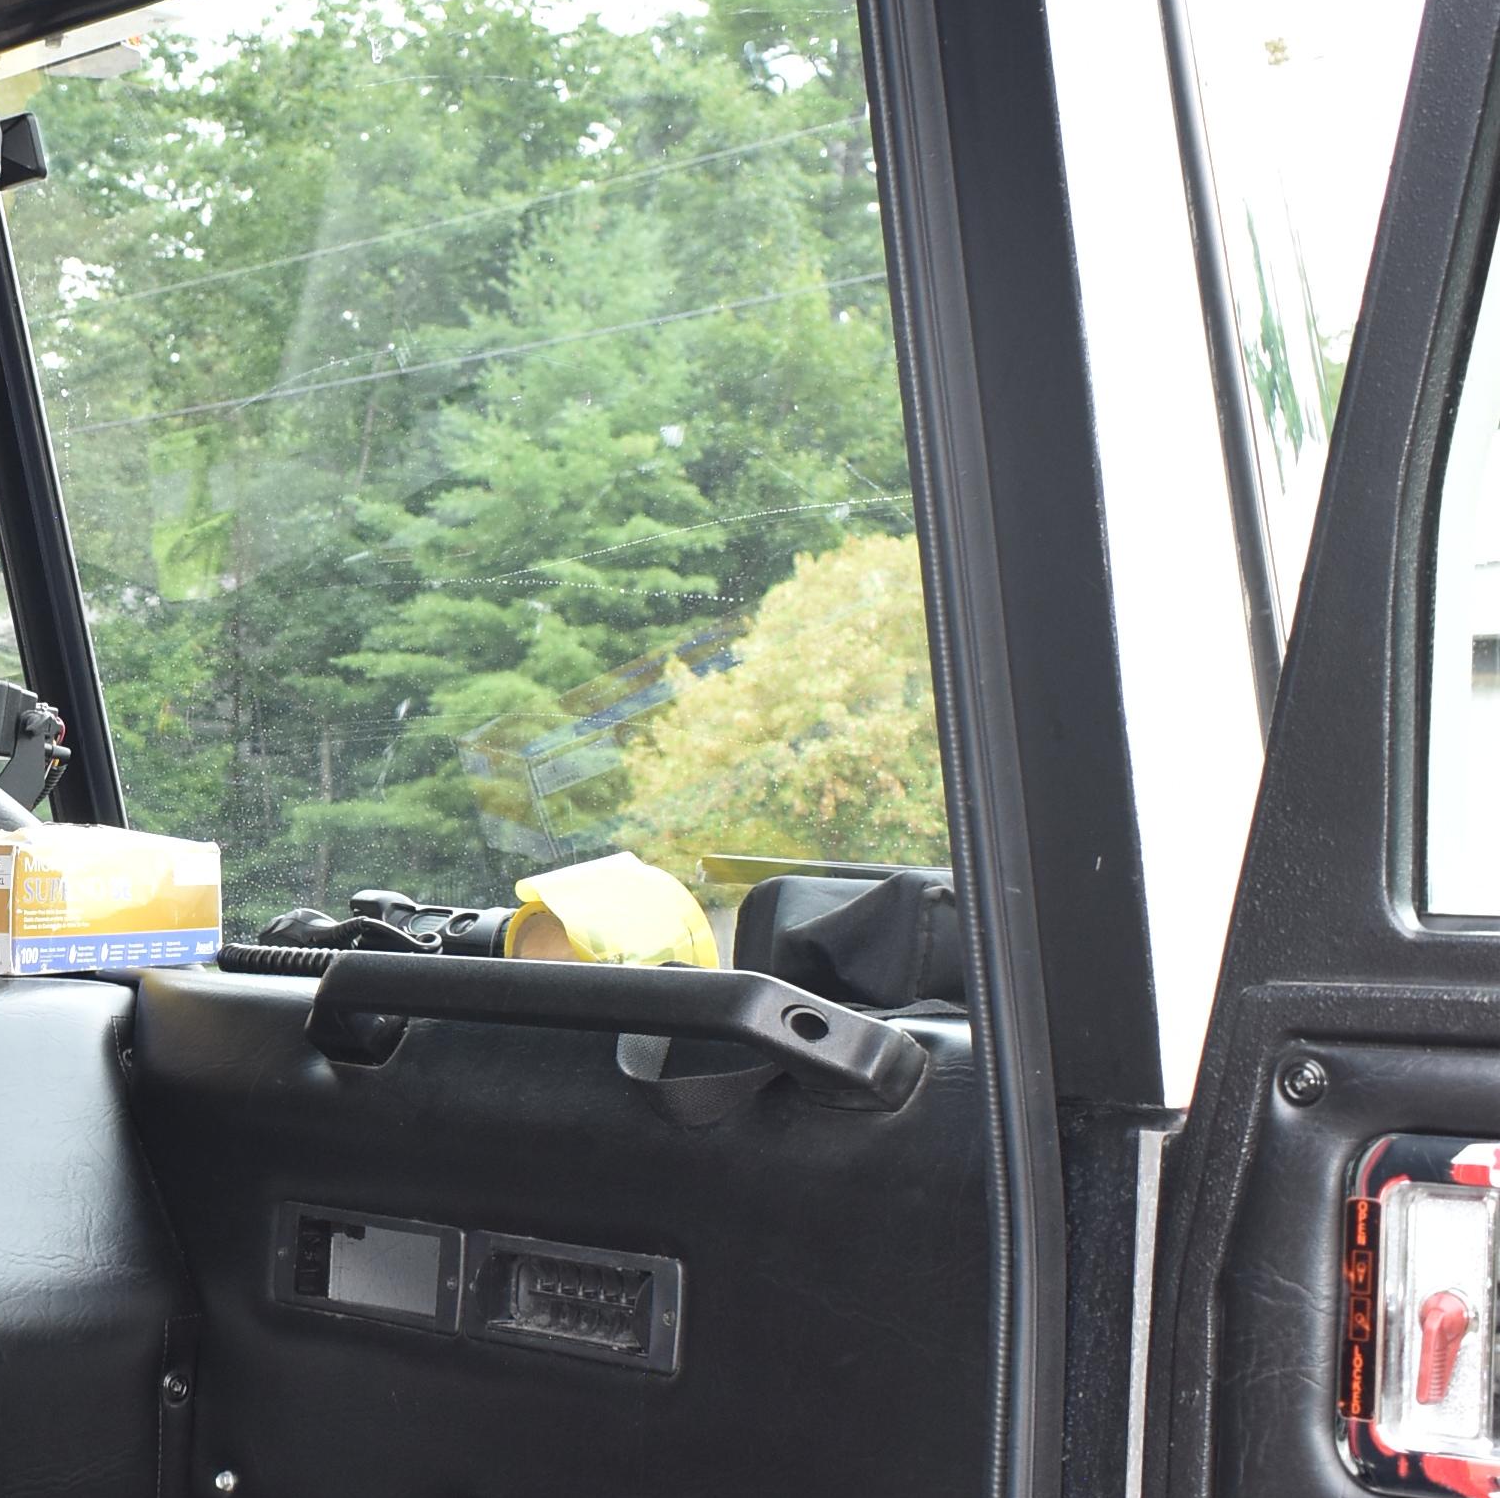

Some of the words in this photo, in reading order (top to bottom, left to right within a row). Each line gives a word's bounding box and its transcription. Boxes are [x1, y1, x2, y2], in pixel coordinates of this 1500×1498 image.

[21, 947, 39, 964] 100
[1356, 1201, 1369, 1246] OPEN
[1351, 1344, 1364, 1415] LOCKED
